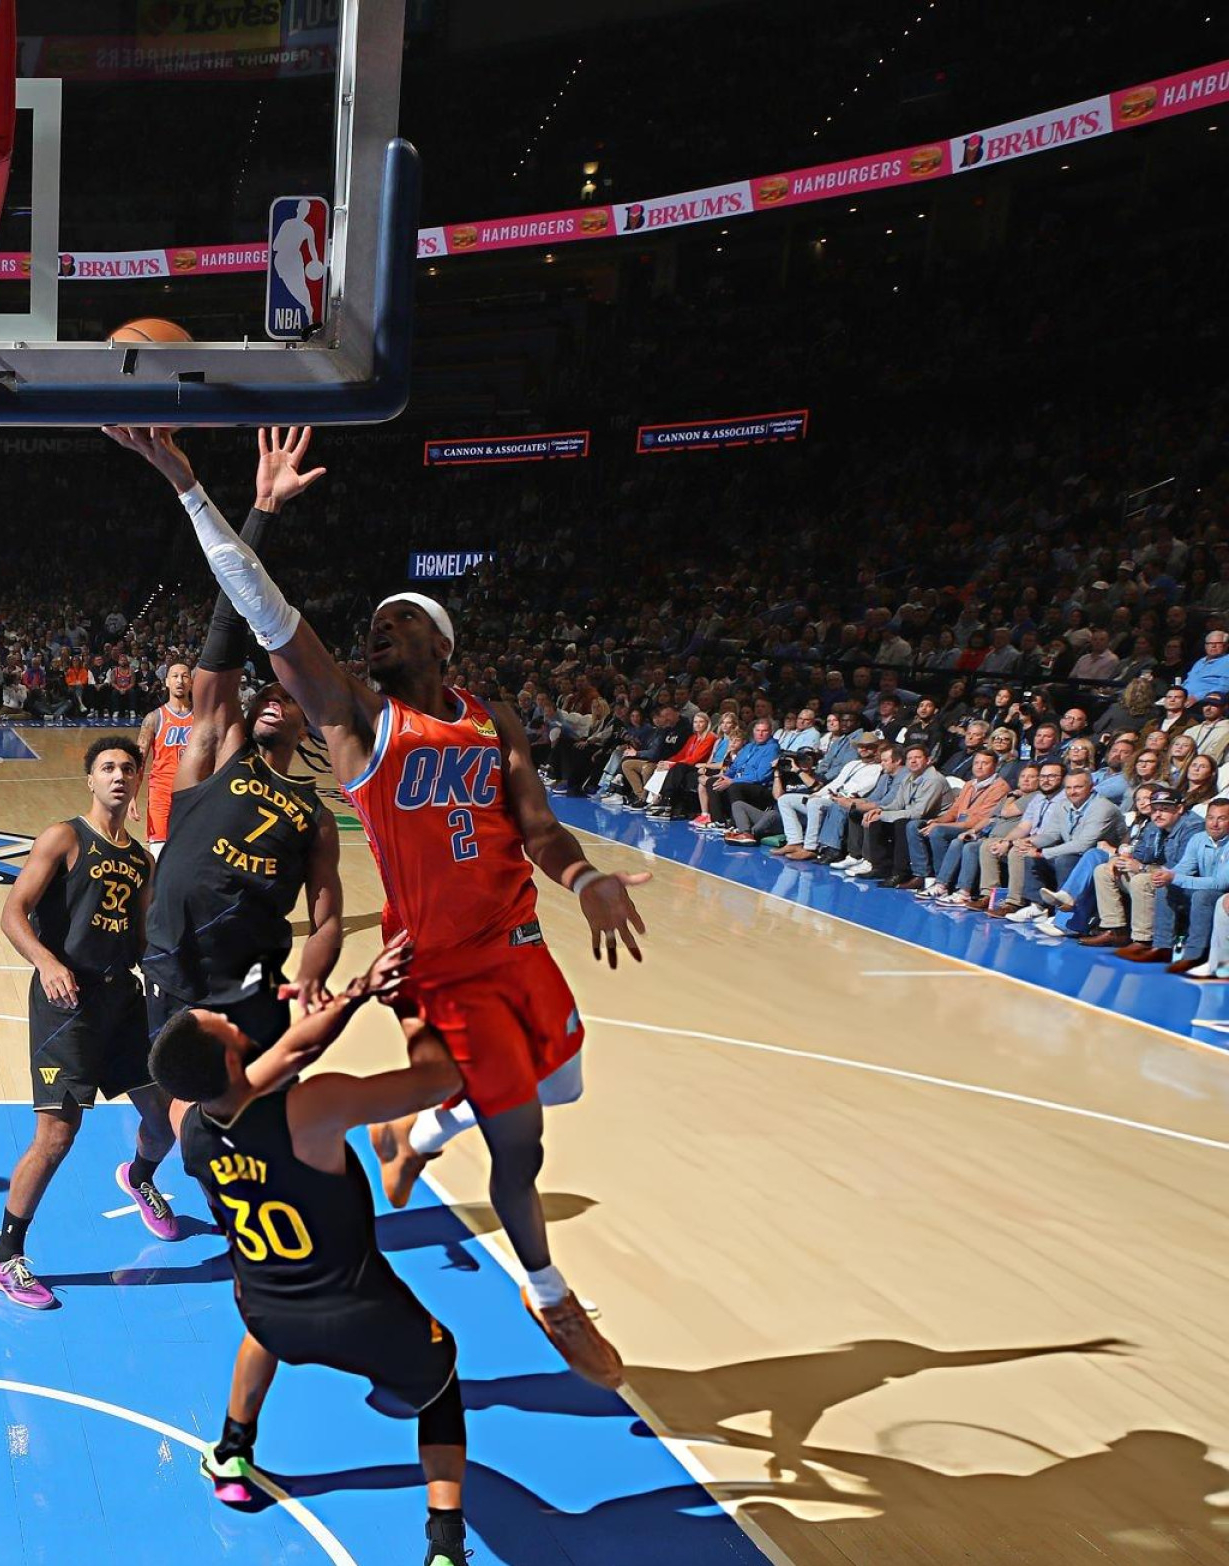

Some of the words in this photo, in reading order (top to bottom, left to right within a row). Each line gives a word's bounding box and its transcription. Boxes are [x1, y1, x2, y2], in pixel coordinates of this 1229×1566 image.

[987, 110, 1103, 162] BRAUM'S
[793, 160, 902, 194] HAMBURGERS
[648, 193, 745, 227] BRAUM'S
[482, 219, 575, 243] HAMBURGERS
[78, 257, 163, 277] BRAUM'S
[201, 251, 268, 267] HAMBURGE
[274, 308, 302, 331] NBA
[657, 431, 700, 443] CANNON
[702, 430, 711, 440] &
[711, 425, 765, 439] ASSOCIATES
[444, 446, 484, 457] CANNON
[486, 446, 494, 456] &
[495, 443, 547, 455] ASSOCIATES
[415, 554, 492, 576] HOMELAN
[164, 725, 192, 747] OK
[395, 745, 502, 811] OKC
[230, 778, 309, 833] GOLDEN
[243, 806, 279, 844] 7
[448, 808, 479, 862] 2
[212, 838, 278, 875] STATE
[89, 860, 143, 889] GOLDEN
[101, 880, 131, 914] 32
[91, 913, 129, 933] STATE
[219, 1194, 313, 1262] 30
